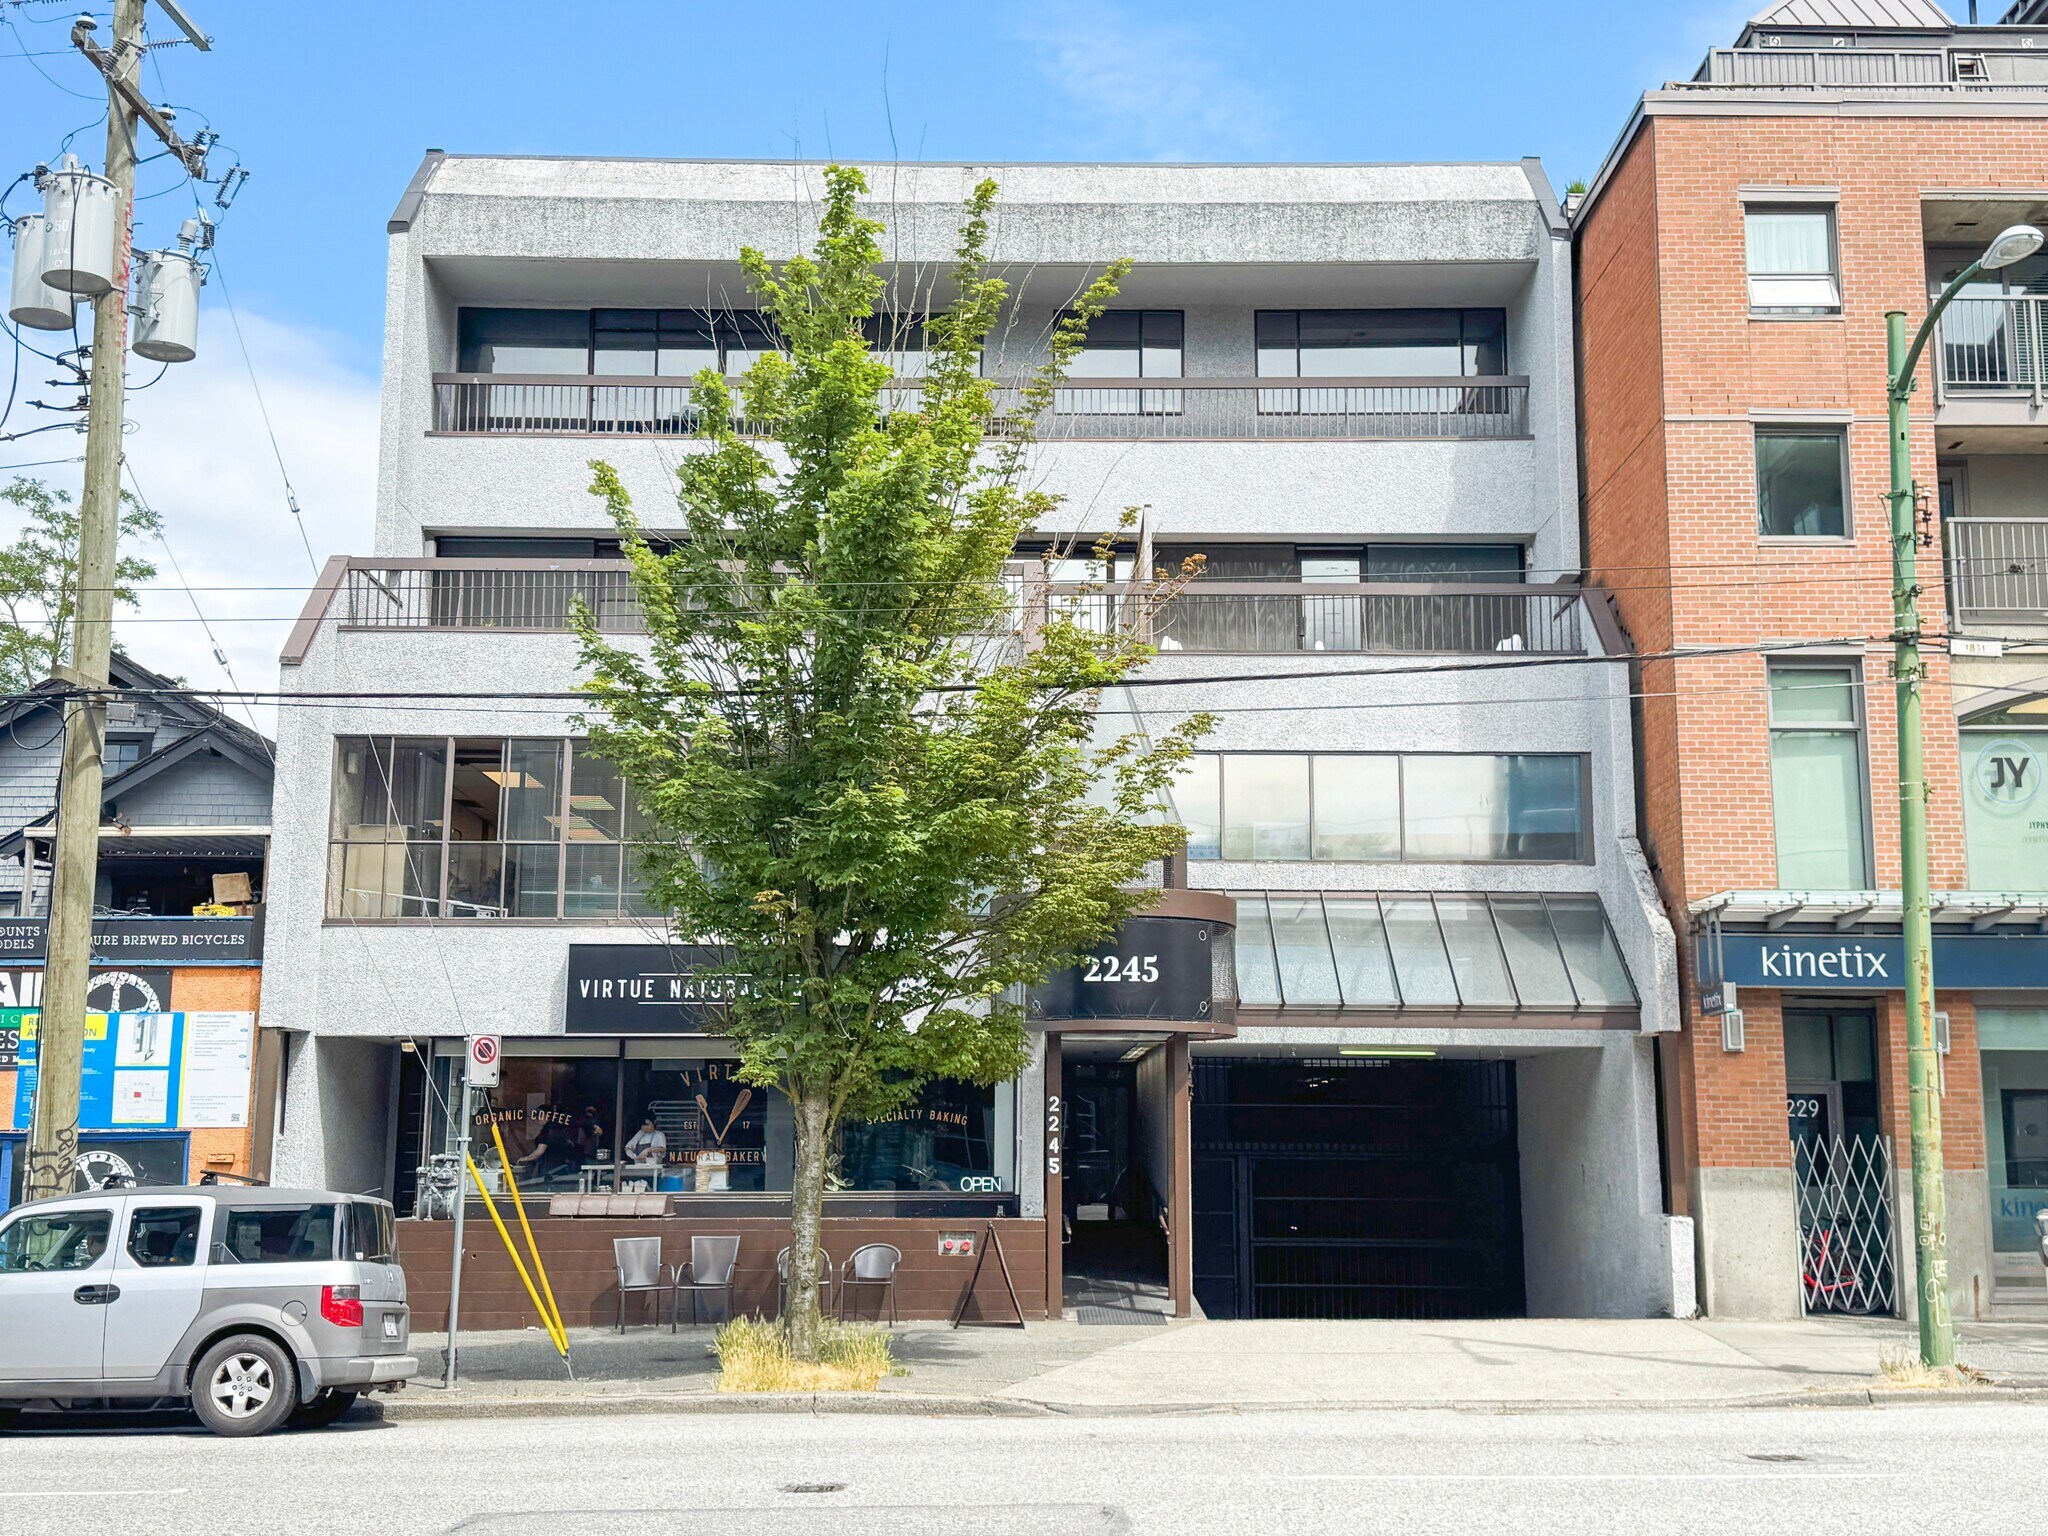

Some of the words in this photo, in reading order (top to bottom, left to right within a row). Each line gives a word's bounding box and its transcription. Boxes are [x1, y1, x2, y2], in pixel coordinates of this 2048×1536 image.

[1989, 757, 2030, 789] JY
[2029, 821, 2048, 829] JYPHY
[0, 926, 40, 937] OUNTS
[0, 939, 35, 949] DELS
[122, 935, 178, 946] BREWED
[181, 934, 245, 945] BICYCLES
[1083, 954, 1159, 983] 2245
[1761, 945, 1888, 978] kinetix
[580, 979, 655, 999] VIRTUE
[680, 1064, 735, 1088] VIRT
[475, 1108, 524, 1127] ORGANIC
[530, 1109, 573, 1127] COFFEE
[683, 1120, 697, 1130] EST
[742, 1120, 751, 1130] 17
[929, 1110, 968, 1126] BAKING
[1048, 1095, 1060, 1175] 2245
[669, 1151, 717, 1162] NATURAL
[725, 1151, 767, 1162] BAKERY
[960, 1176, 1002, 1192] OPEN
